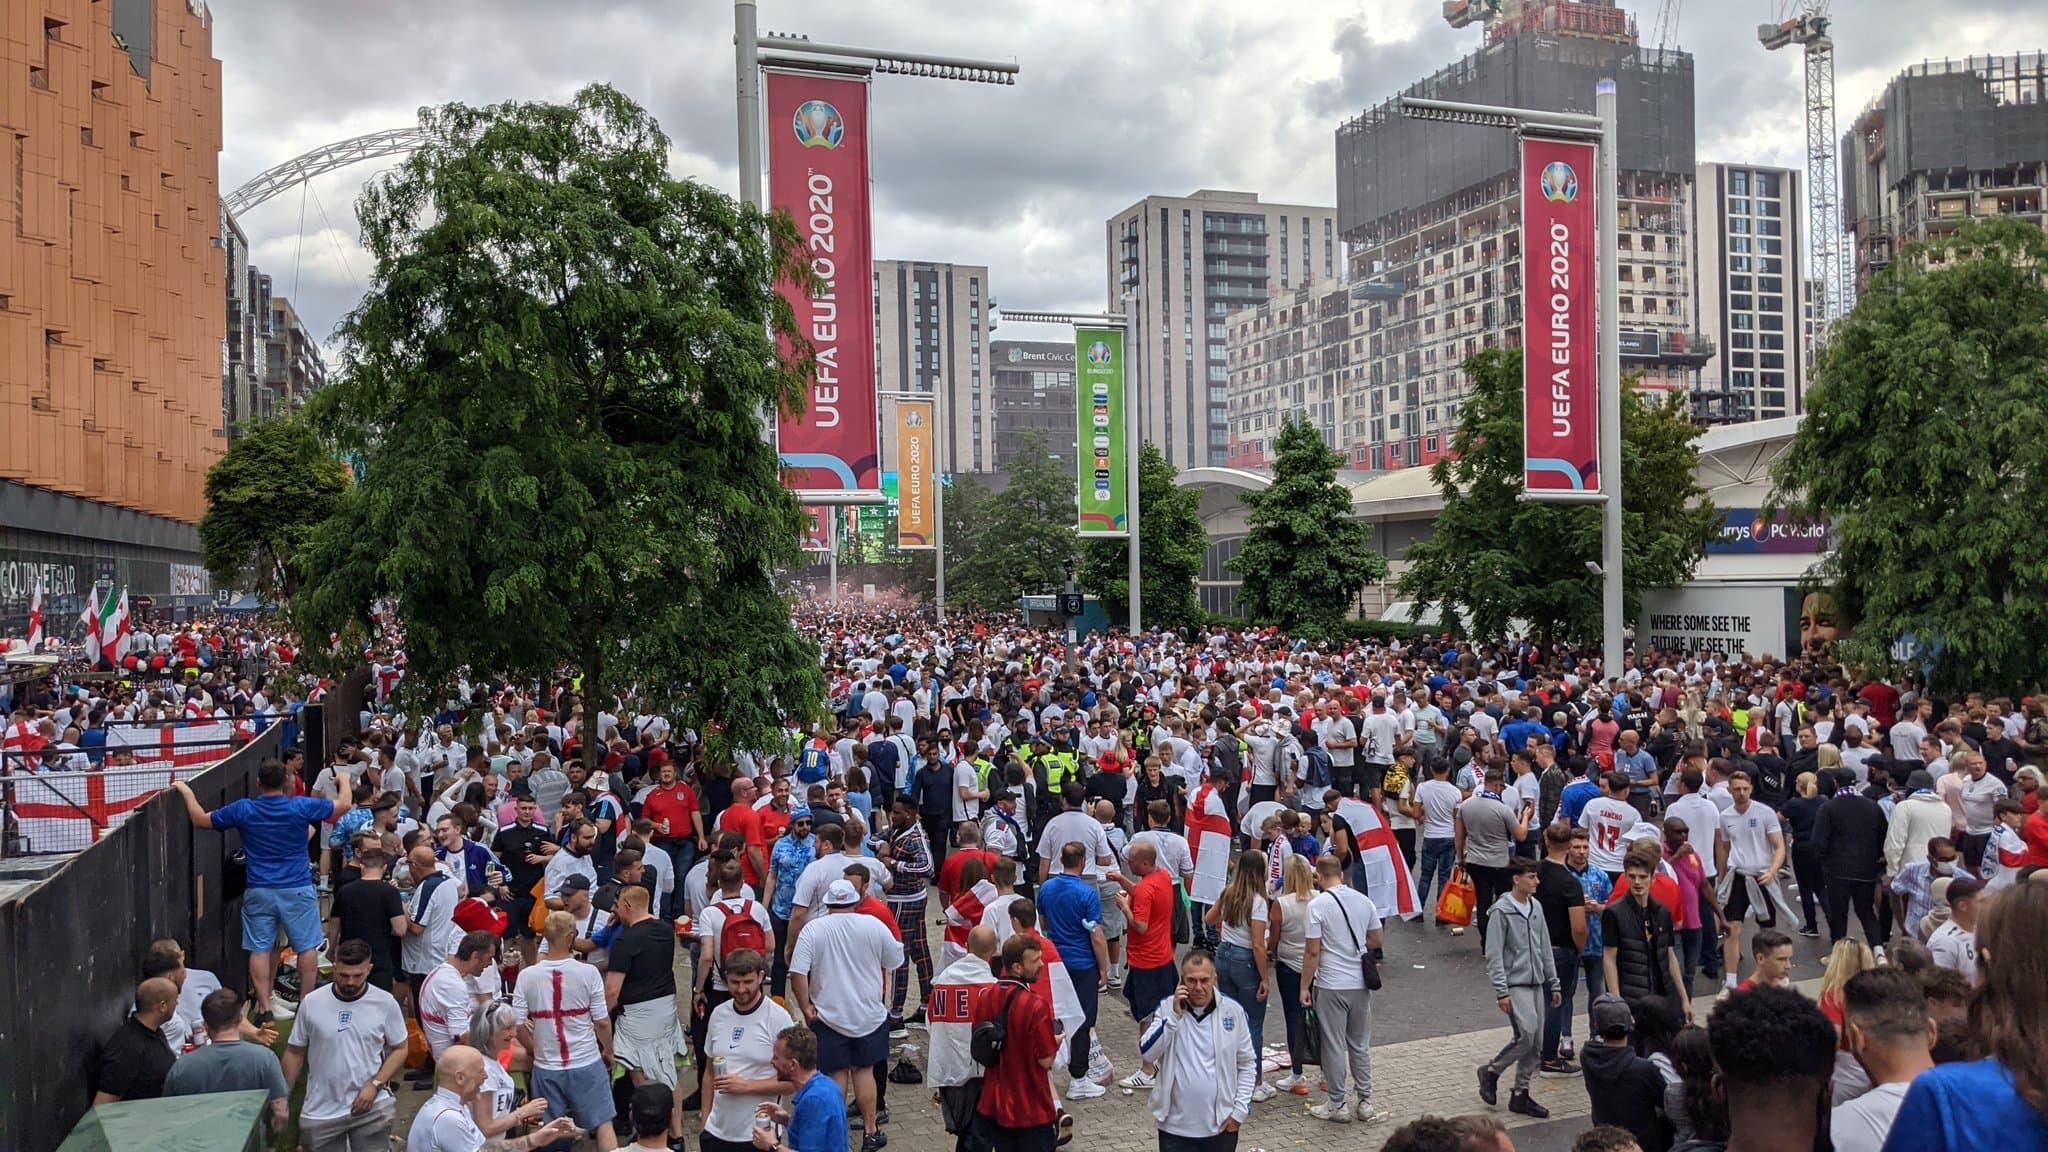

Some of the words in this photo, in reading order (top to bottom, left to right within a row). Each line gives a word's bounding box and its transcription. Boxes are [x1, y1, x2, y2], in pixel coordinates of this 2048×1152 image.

[1551, 293, 1570, 365] EURO
[1023, 351, 1046, 360] Brent
[1046, 352, 1064, 361] Civic
[1065, 353, 1075, 362] Ce
[815, 346, 839, 427] UEFA
[1552, 368, 1571, 437] UEFA
[910, 436, 920, 465] 2020
[911, 465, 920, 495] EURO
[887, 496, 899, 506] En
[911, 495, 921, 525] UEFA
[1716, 525, 1750, 541] urrys
[1771, 523, 1788, 538] PC
[217, 589, 230, 602] B
[1650, 614, 1682, 631] WHERE
[1684, 615, 1710, 631] SOME
[1711, 616, 1729, 632] SEE
[1731, 616, 1751, 633] THE
[1690, 637, 1705, 652] WE
[1706, 638, 1724, 653] SEE
[1726, 638, 1745, 655] THE
[806, 751, 819, 769] 10
[1600, 809, 1623, 821] SANCHO
[1597, 822, 1621, 852] 17
